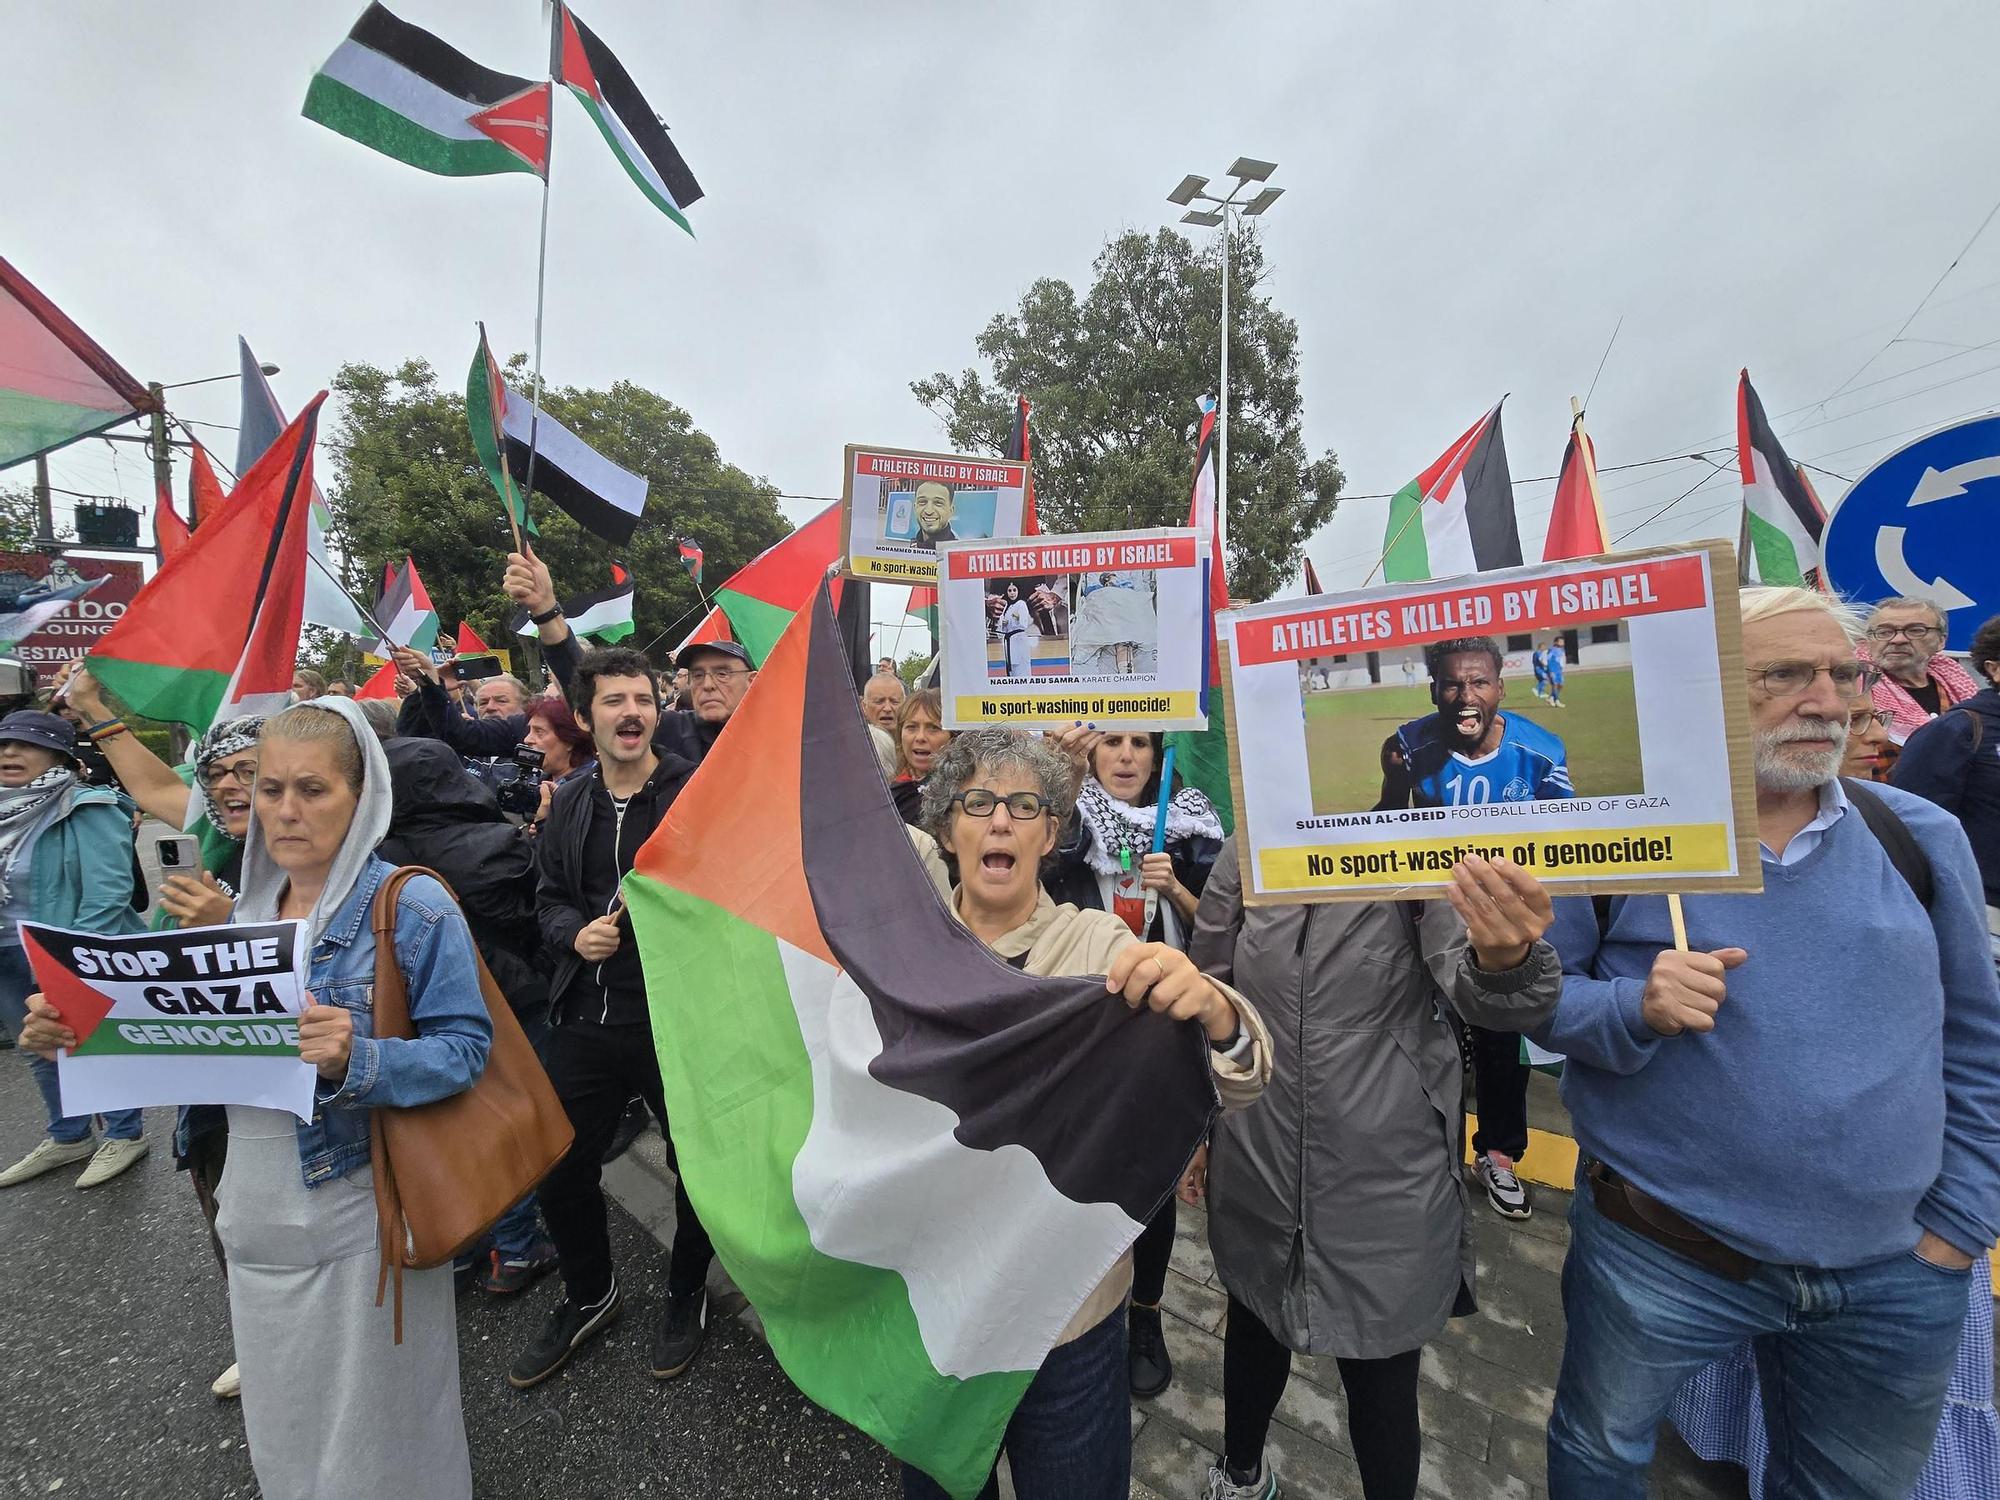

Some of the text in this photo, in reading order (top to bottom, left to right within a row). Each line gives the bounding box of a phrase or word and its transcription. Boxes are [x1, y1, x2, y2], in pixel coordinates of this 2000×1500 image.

[871, 459, 1009, 483] ATHLETES KILLED BY ISRAEL
[871, 561, 882, 572] No
[968, 544, 1174, 573] ATHLETES KILLED BY ISRAEL
[1272, 573, 1658, 652] ATHLETES KILLED BY ISRAEL
[990, 674, 1156, 686] NAGHAM ABU SAMRA KARATE CHAMPION
[982, 697, 1171, 717] No sport-washing of genocide!
[1446, 775, 1490, 806] 10
[1296, 797, 1670, 831] SULEIMAN AL-OBEID FOOTBALL LEGEND OF GAZA
[1308, 853, 1335, 876] No
[1513, 842, 1537, 866] of
[1544, 836, 1673, 867] genocide!
[71, 937, 280, 977] STOP THE
[142, 981, 289, 1016] GAZA
[117, 1023, 301, 1047] GENOCIDE
